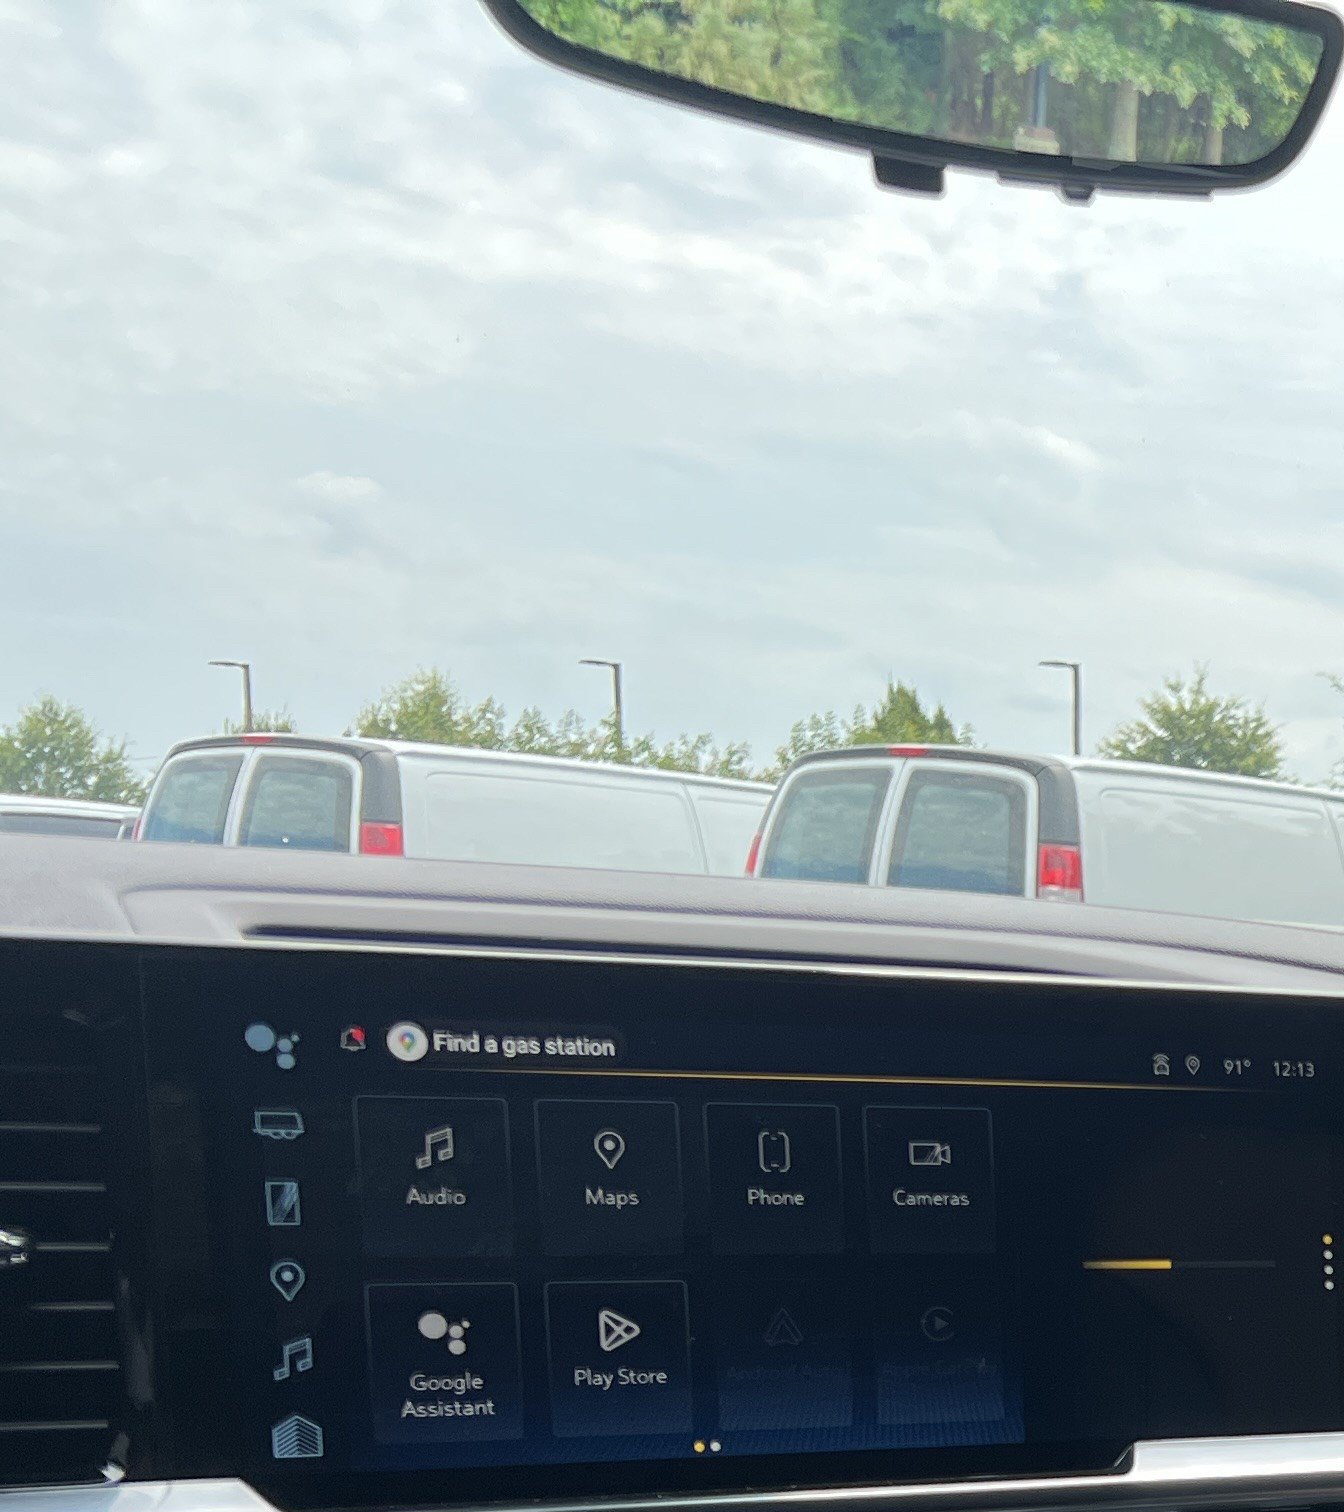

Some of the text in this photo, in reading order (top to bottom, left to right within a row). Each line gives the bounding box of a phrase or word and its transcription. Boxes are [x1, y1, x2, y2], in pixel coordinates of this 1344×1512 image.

[433, 1031, 616, 1058] Find a gas station
[1273, 1060, 1315, 1078] 12:13
[406, 1186, 466, 1206] Audio
[585, 1188, 639, 1210] Maps
[748, 1188, 804, 1206] Phone
[892, 1188, 970, 1208] Cameras
[409, 1372, 484, 1395] Google
[574, 1366, 667, 1391] Play Store
[401, 1398, 495, 1419] Assistant
